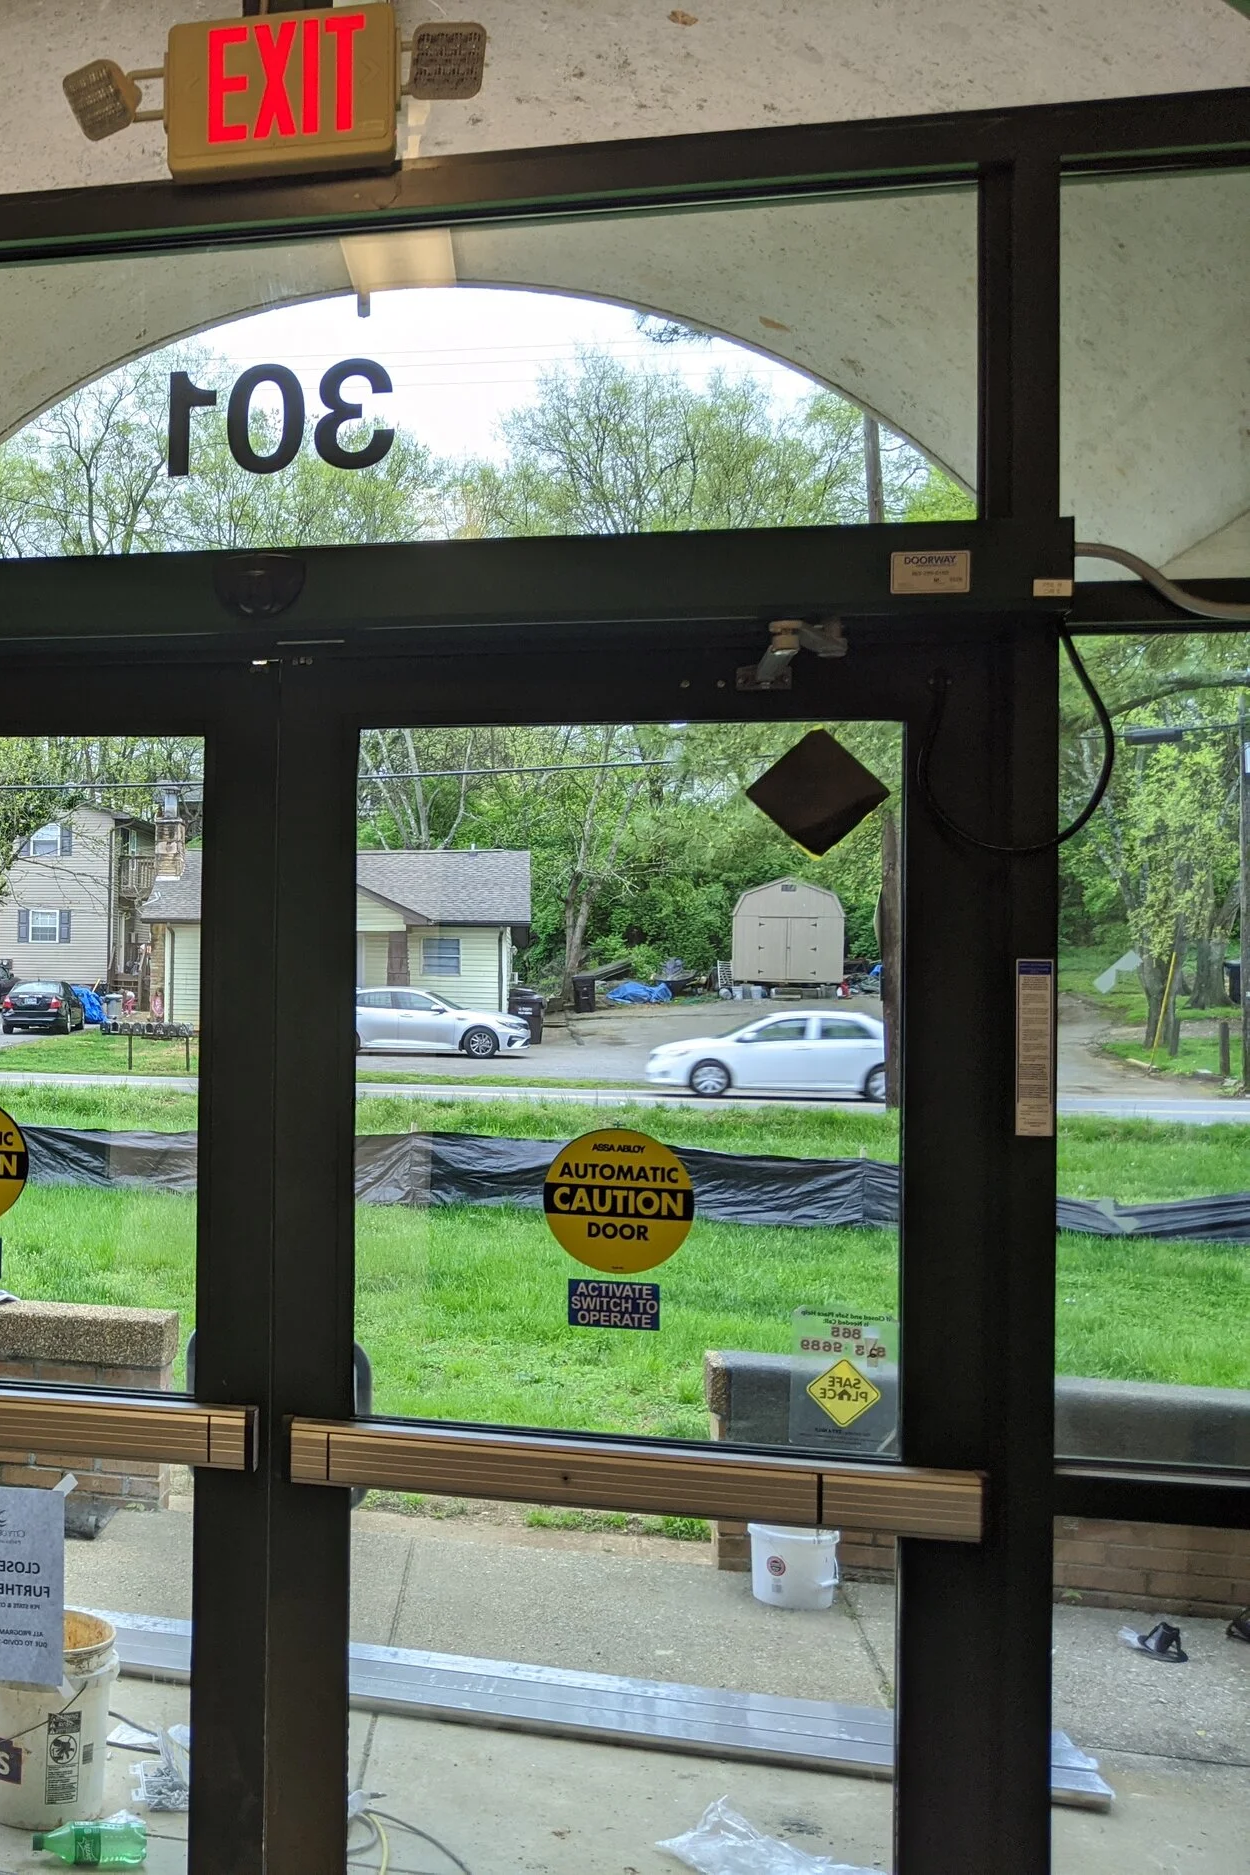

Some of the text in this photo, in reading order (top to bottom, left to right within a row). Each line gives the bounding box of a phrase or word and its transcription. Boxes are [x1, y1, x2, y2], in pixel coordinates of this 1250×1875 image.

[207, 14, 365, 144] EXIT
[904, 555, 957, 566] DOORWAY
[592, 1143, 645, 1153] ASSA ABLOY
[558, 1162, 679, 1183] AUTOMATIC
[553, 1186, 683, 1217] CAUTION
[587, 1222, 649, 1241] DOOR
[576, 1282, 653, 1299] ACTIVATE
[571, 1296, 658, 1314] SWITCH TO
[577, 1311, 652, 1328] OPERATE
